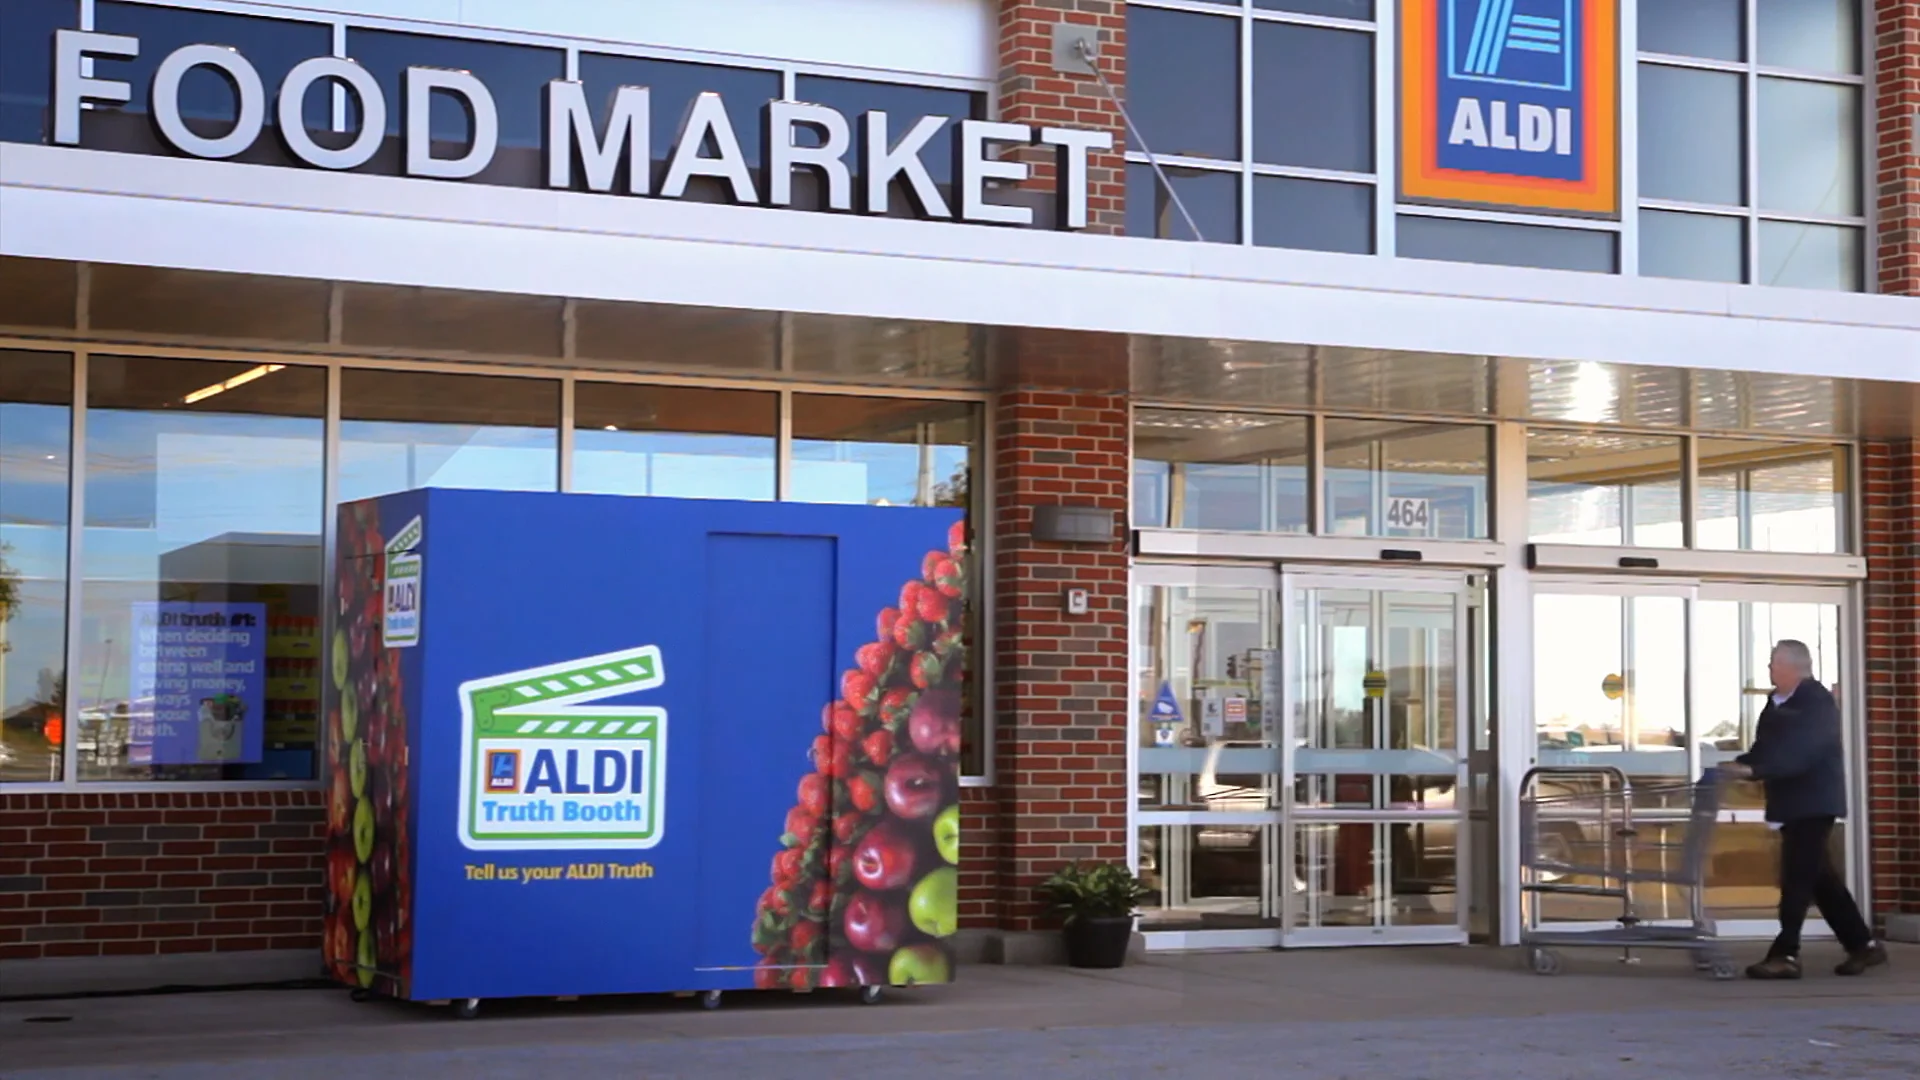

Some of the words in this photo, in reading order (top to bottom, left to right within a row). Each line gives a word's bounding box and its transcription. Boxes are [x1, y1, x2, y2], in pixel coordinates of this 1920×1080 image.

[53, 28, 499, 179] FOOD
[546, 78, 1113, 229] MARKET
[1448, 97, 1572, 155] ALDI
[1388, 499, 1428, 527] 464
[180, 611, 226, 627] truth
[185, 628, 250, 648] deciding
[190, 660, 223, 673] well
[224, 660, 255, 674] and
[191, 679, 247, 693] money,
[138, 692, 192, 708] ways
[138, 705, 191, 721] oose
[523, 748, 643, 794] ALDI
[482, 799, 555, 822] Truth
[562, 799, 641, 822] Booth
[464, 863, 494, 880] Tell
[499, 868, 518, 880] us
[521, 867, 563, 885] your
[565, 864, 604, 880] ALDI
[608, 862, 653, 879] Truth
